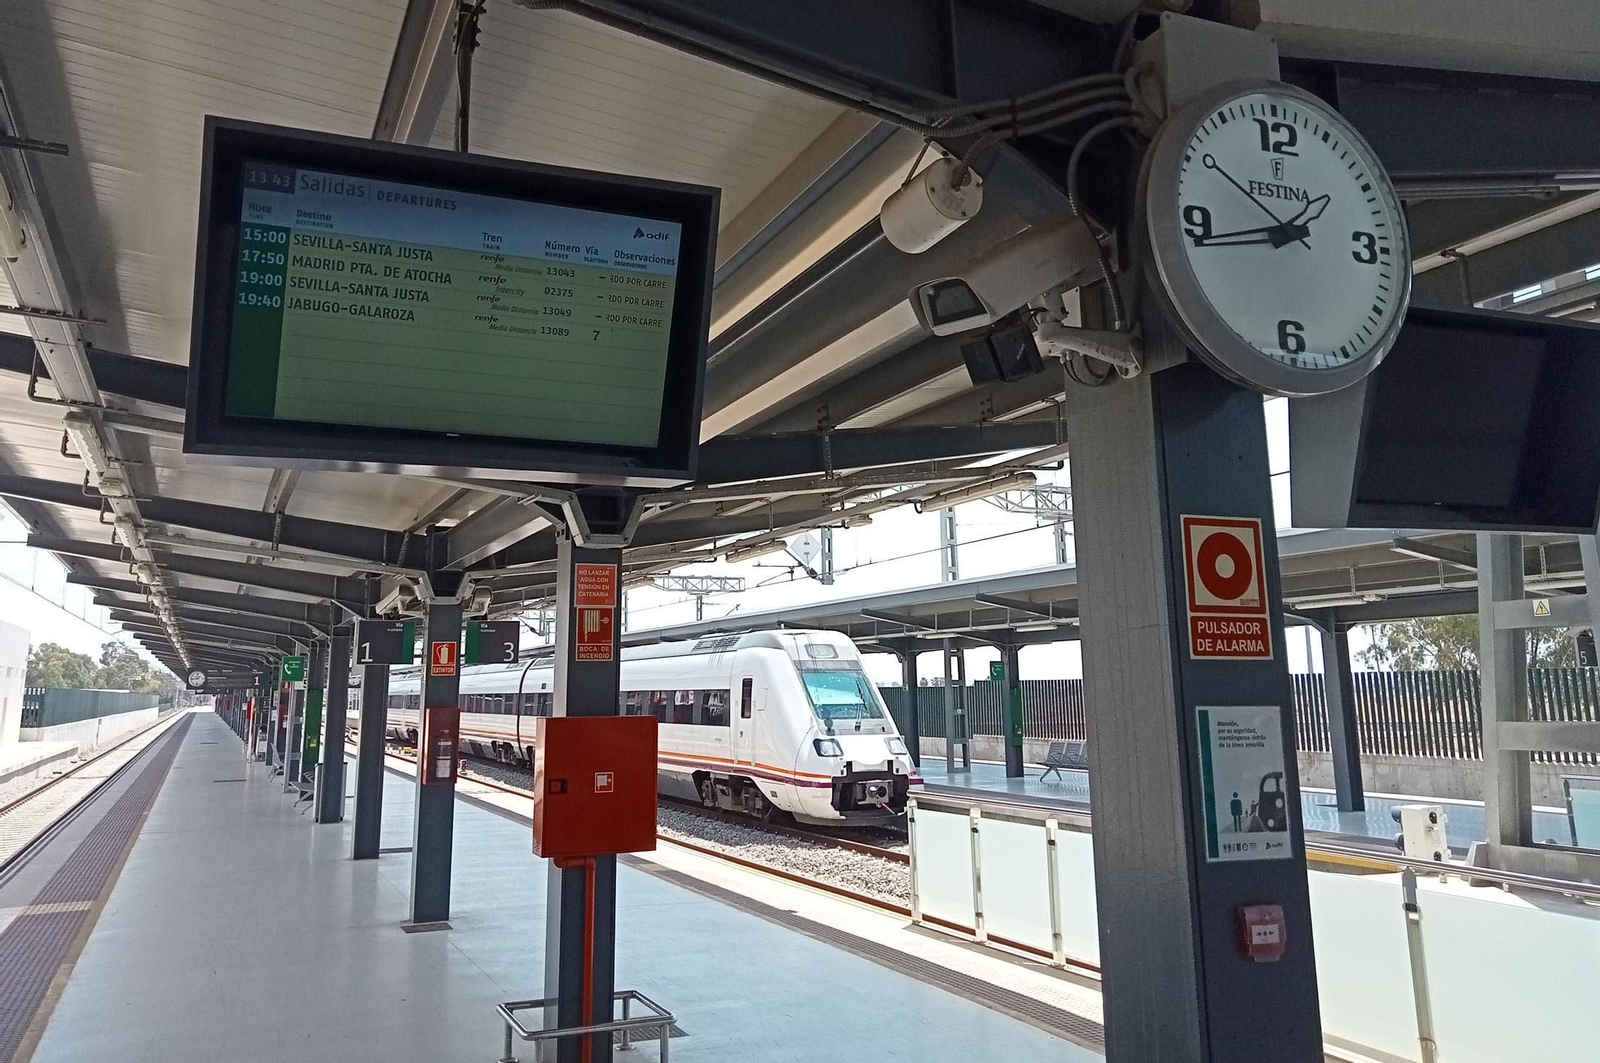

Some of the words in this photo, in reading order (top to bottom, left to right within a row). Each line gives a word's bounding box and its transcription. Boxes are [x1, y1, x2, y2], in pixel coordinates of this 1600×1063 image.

[1253, 118, 1299, 157] 12
[300, 174, 365, 198] Salidas
[1248, 180, 1310, 203] FESTINA
[376, 190, 458, 211] DEPARTURES
[248, 202, 272, 214] Hora
[296, 209, 332, 221] Destino
[1183, 204, 1212, 240] 9
[243, 228, 287, 244] 15:00
[482, 232, 503, 243] Tren
[646, 232, 671, 241] adif
[293, 233, 393, 257] SEVILLA-SANTA
[396, 246, 434, 262] JUSTA
[544, 240, 581, 254] Número
[585, 245, 599, 256] Vía
[1352, 231, 1378, 265] 3
[241, 248, 286, 265] 17:50
[480, 254, 505, 264] renfe
[544, 252, 570, 260] NUMBER
[614, 249, 676, 266] Observaciones
[291, 254, 346, 272] MADRID
[350, 262, 378, 277] PTA.
[383, 265, 401, 279] DE
[404, 268, 452, 285] ATOCHA
[546, 266, 576, 278] 13043
[240, 270, 284, 287] 19:00
[478, 275, 507, 286] renfe
[626, 276, 642, 286] POR
[644, 280, 668, 289] CARRE
[289, 276, 389, 299] SEVILLA-SANTA
[392, 287, 430, 302] JUSTA
[495, 286, 526, 296] Intercity
[544, 286, 574, 298] 02375
[238, 291, 282, 308] 19:40
[476, 294, 501, 304] renfe
[624, 296, 640, 306] POR
[642, 299, 665, 308] CARRE
[286, 296, 415, 322] JABUGO-GALAROZA
[542, 306, 572, 318] 13049
[474, 314, 499, 324] renfe
[622, 316, 638, 324] POR
[640, 318, 663, 327] CARRE
[540, 326, 570, 337] 13089
[592, 330, 600, 341] 7
[1278, 319, 1306, 354] 6
[1197, 621, 1262, 635] PULSADOR
[361, 642, 373, 662] 1
[503, 642, 515, 662] 3
[1196, 638, 1214, 652] DE
[1216, 639, 1265, 652] ALARMA
[1580, 650, 1588, 665] 5
[433, 666, 454, 674] EXTINTOR
[254, 676, 260, 686] 1
